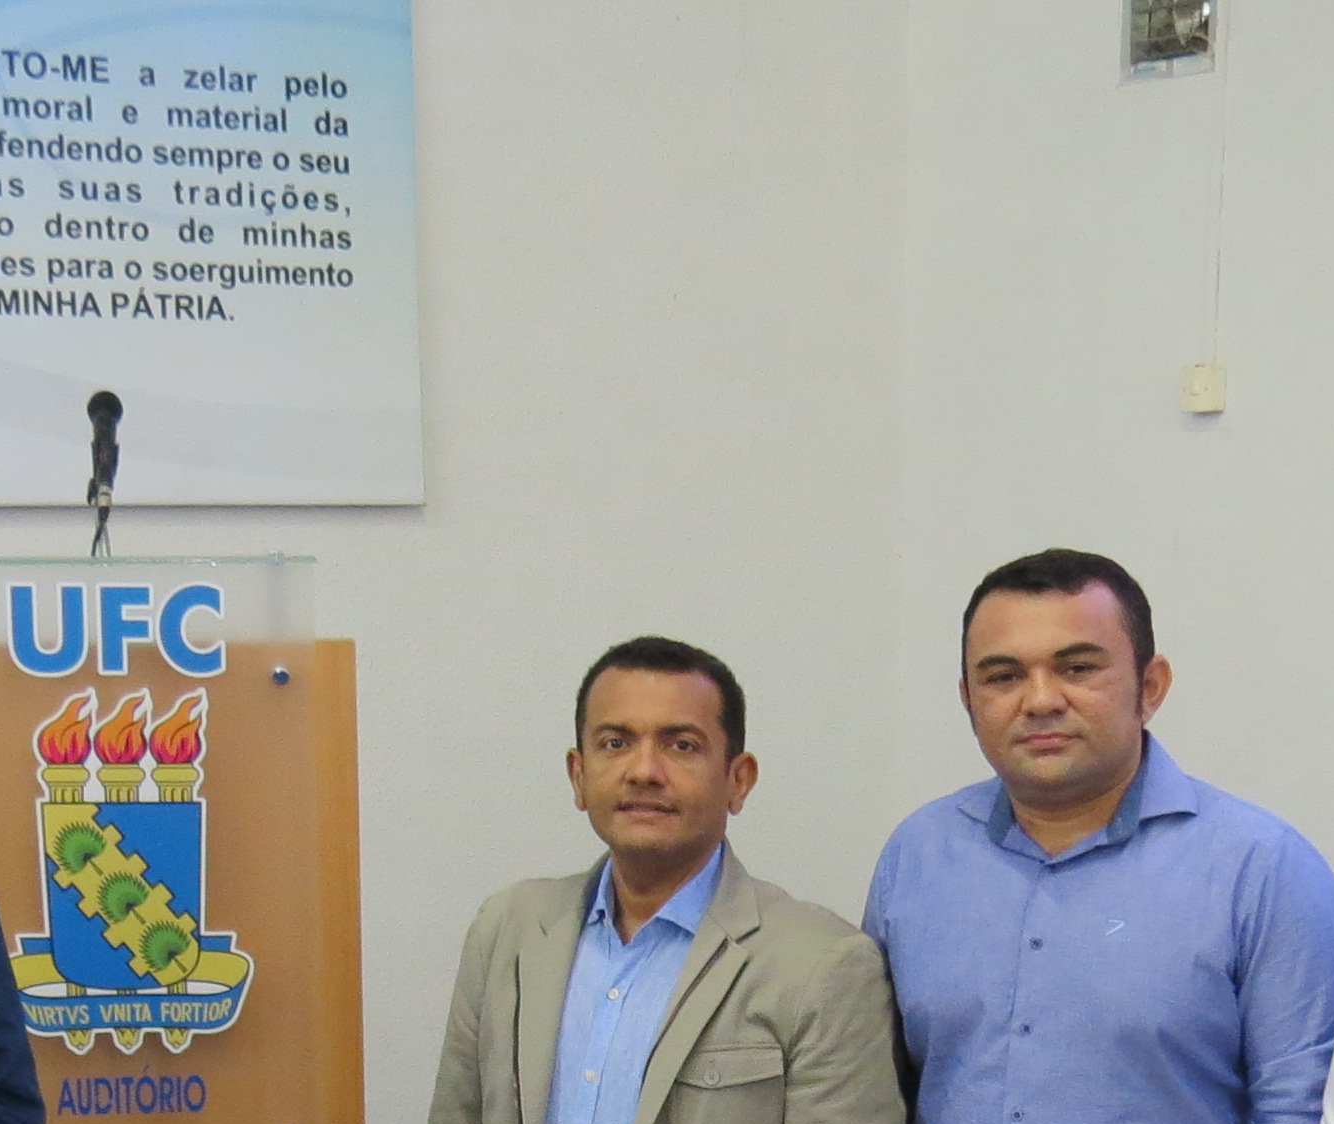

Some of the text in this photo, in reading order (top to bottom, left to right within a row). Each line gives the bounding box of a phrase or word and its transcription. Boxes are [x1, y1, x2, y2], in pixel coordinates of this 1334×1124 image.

[140, 67, 155, 87] a
[184, 66, 257, 92] zelar
[285, 72, 347, 102] pelo
[3, 95, 92, 121] moral
[122, 105, 138, 124] e
[167, 105, 287, 133] material
[314, 110, 348, 137] da
[153, 146, 263, 174] sempre
[273, 152, 290, 171] o
[300, 153, 349, 174] seu
[59, 179, 142, 203] suas
[174, 180, 350, 217] tradições,
[45, 213, 149, 241] dentro
[179, 217, 214, 244] de
[243, 221, 352, 250] minhas
[47, 258, 113, 284] para
[125, 260, 142, 280] o
[153, 259, 353, 290] soerguimento
[111, 287, 234, 321] PÁTRIA.
[8, 583, 225, 676] UFC
[99, 1002, 152, 1023] VNITA
[161, 997, 233, 1023] FORTIOR
[57, 1066, 207, 1115] AUDITÓRIO
